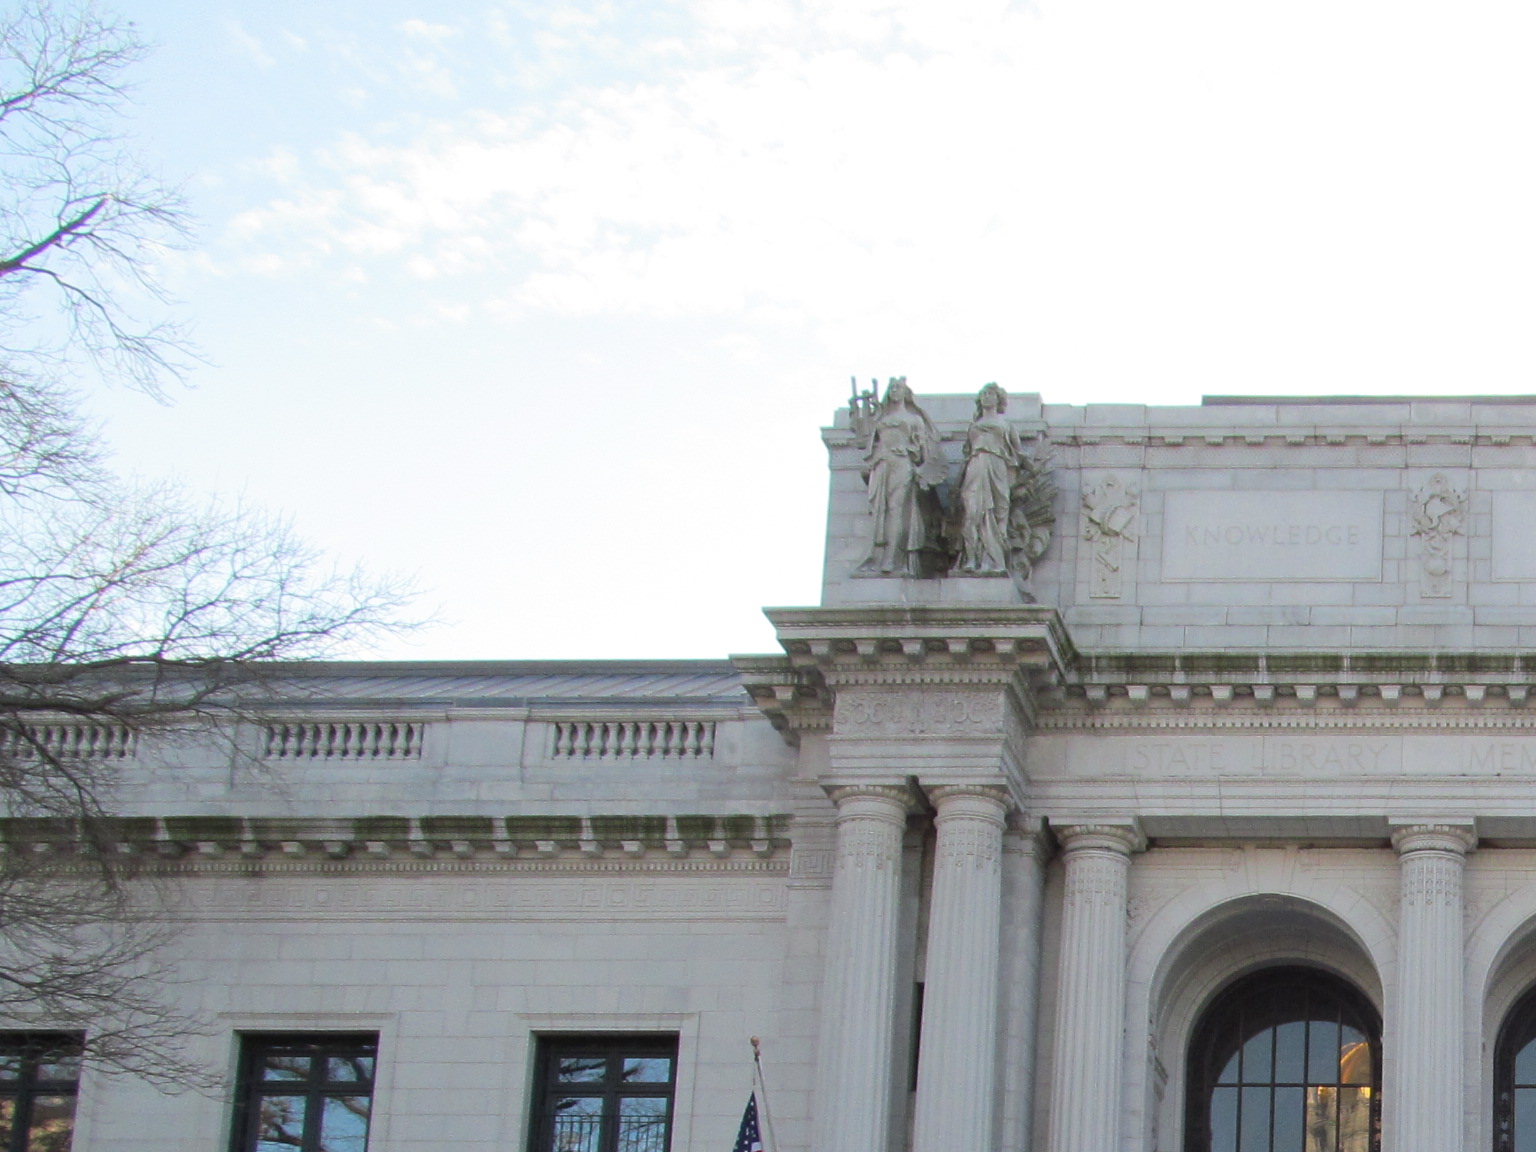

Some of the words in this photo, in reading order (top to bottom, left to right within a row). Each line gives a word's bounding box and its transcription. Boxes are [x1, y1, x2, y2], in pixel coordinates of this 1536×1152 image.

[1184, 524, 1360, 546] KNOWLEDGE
[1133, 743, 1225, 770] STATE
[1250, 743, 1388, 770] LIBRARY
